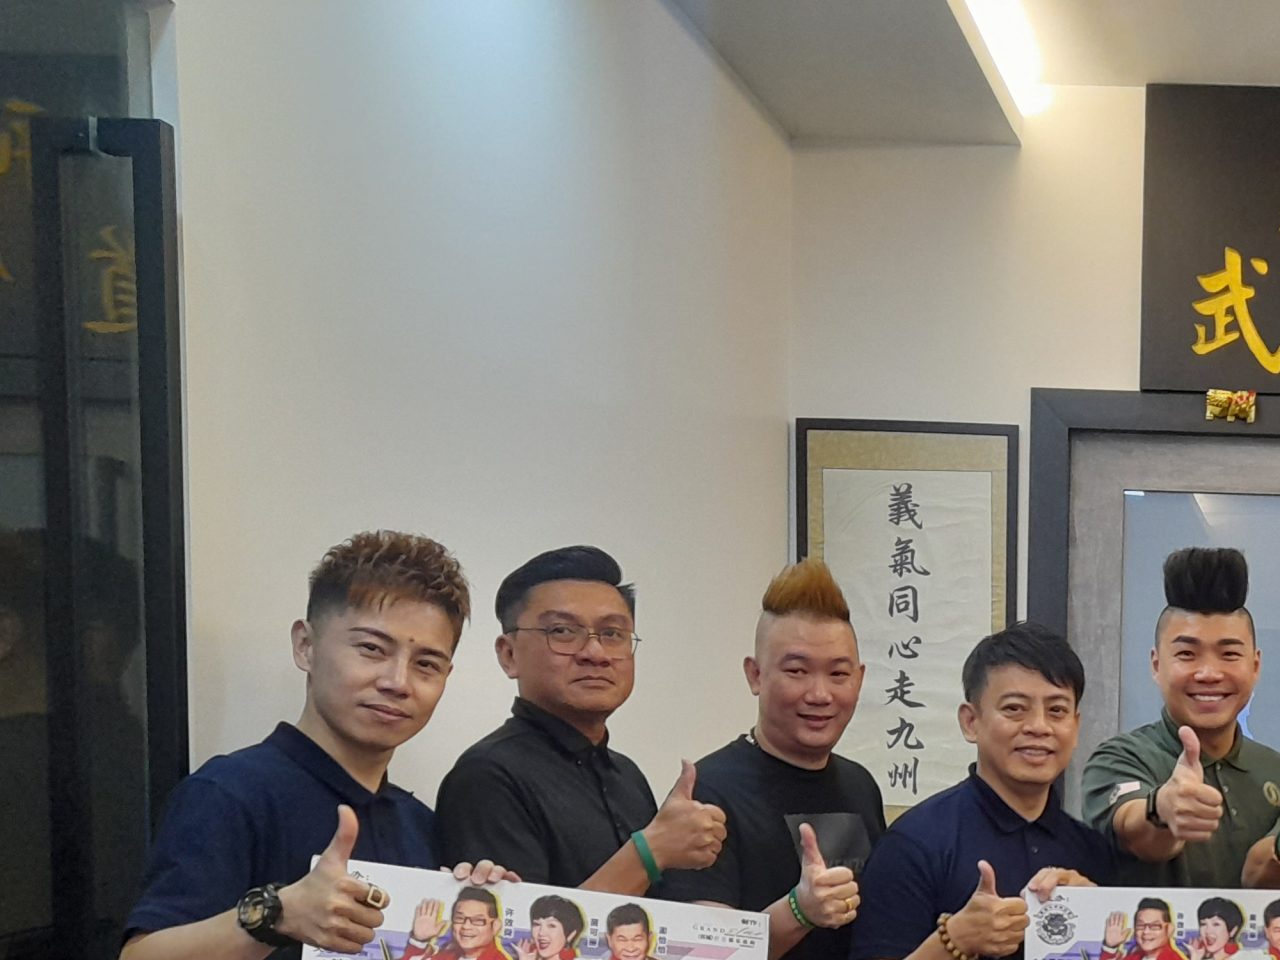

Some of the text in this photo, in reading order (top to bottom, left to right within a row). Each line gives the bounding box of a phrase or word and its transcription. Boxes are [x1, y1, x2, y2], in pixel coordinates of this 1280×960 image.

[884, 482, 931, 796] 義氣同心走九州
